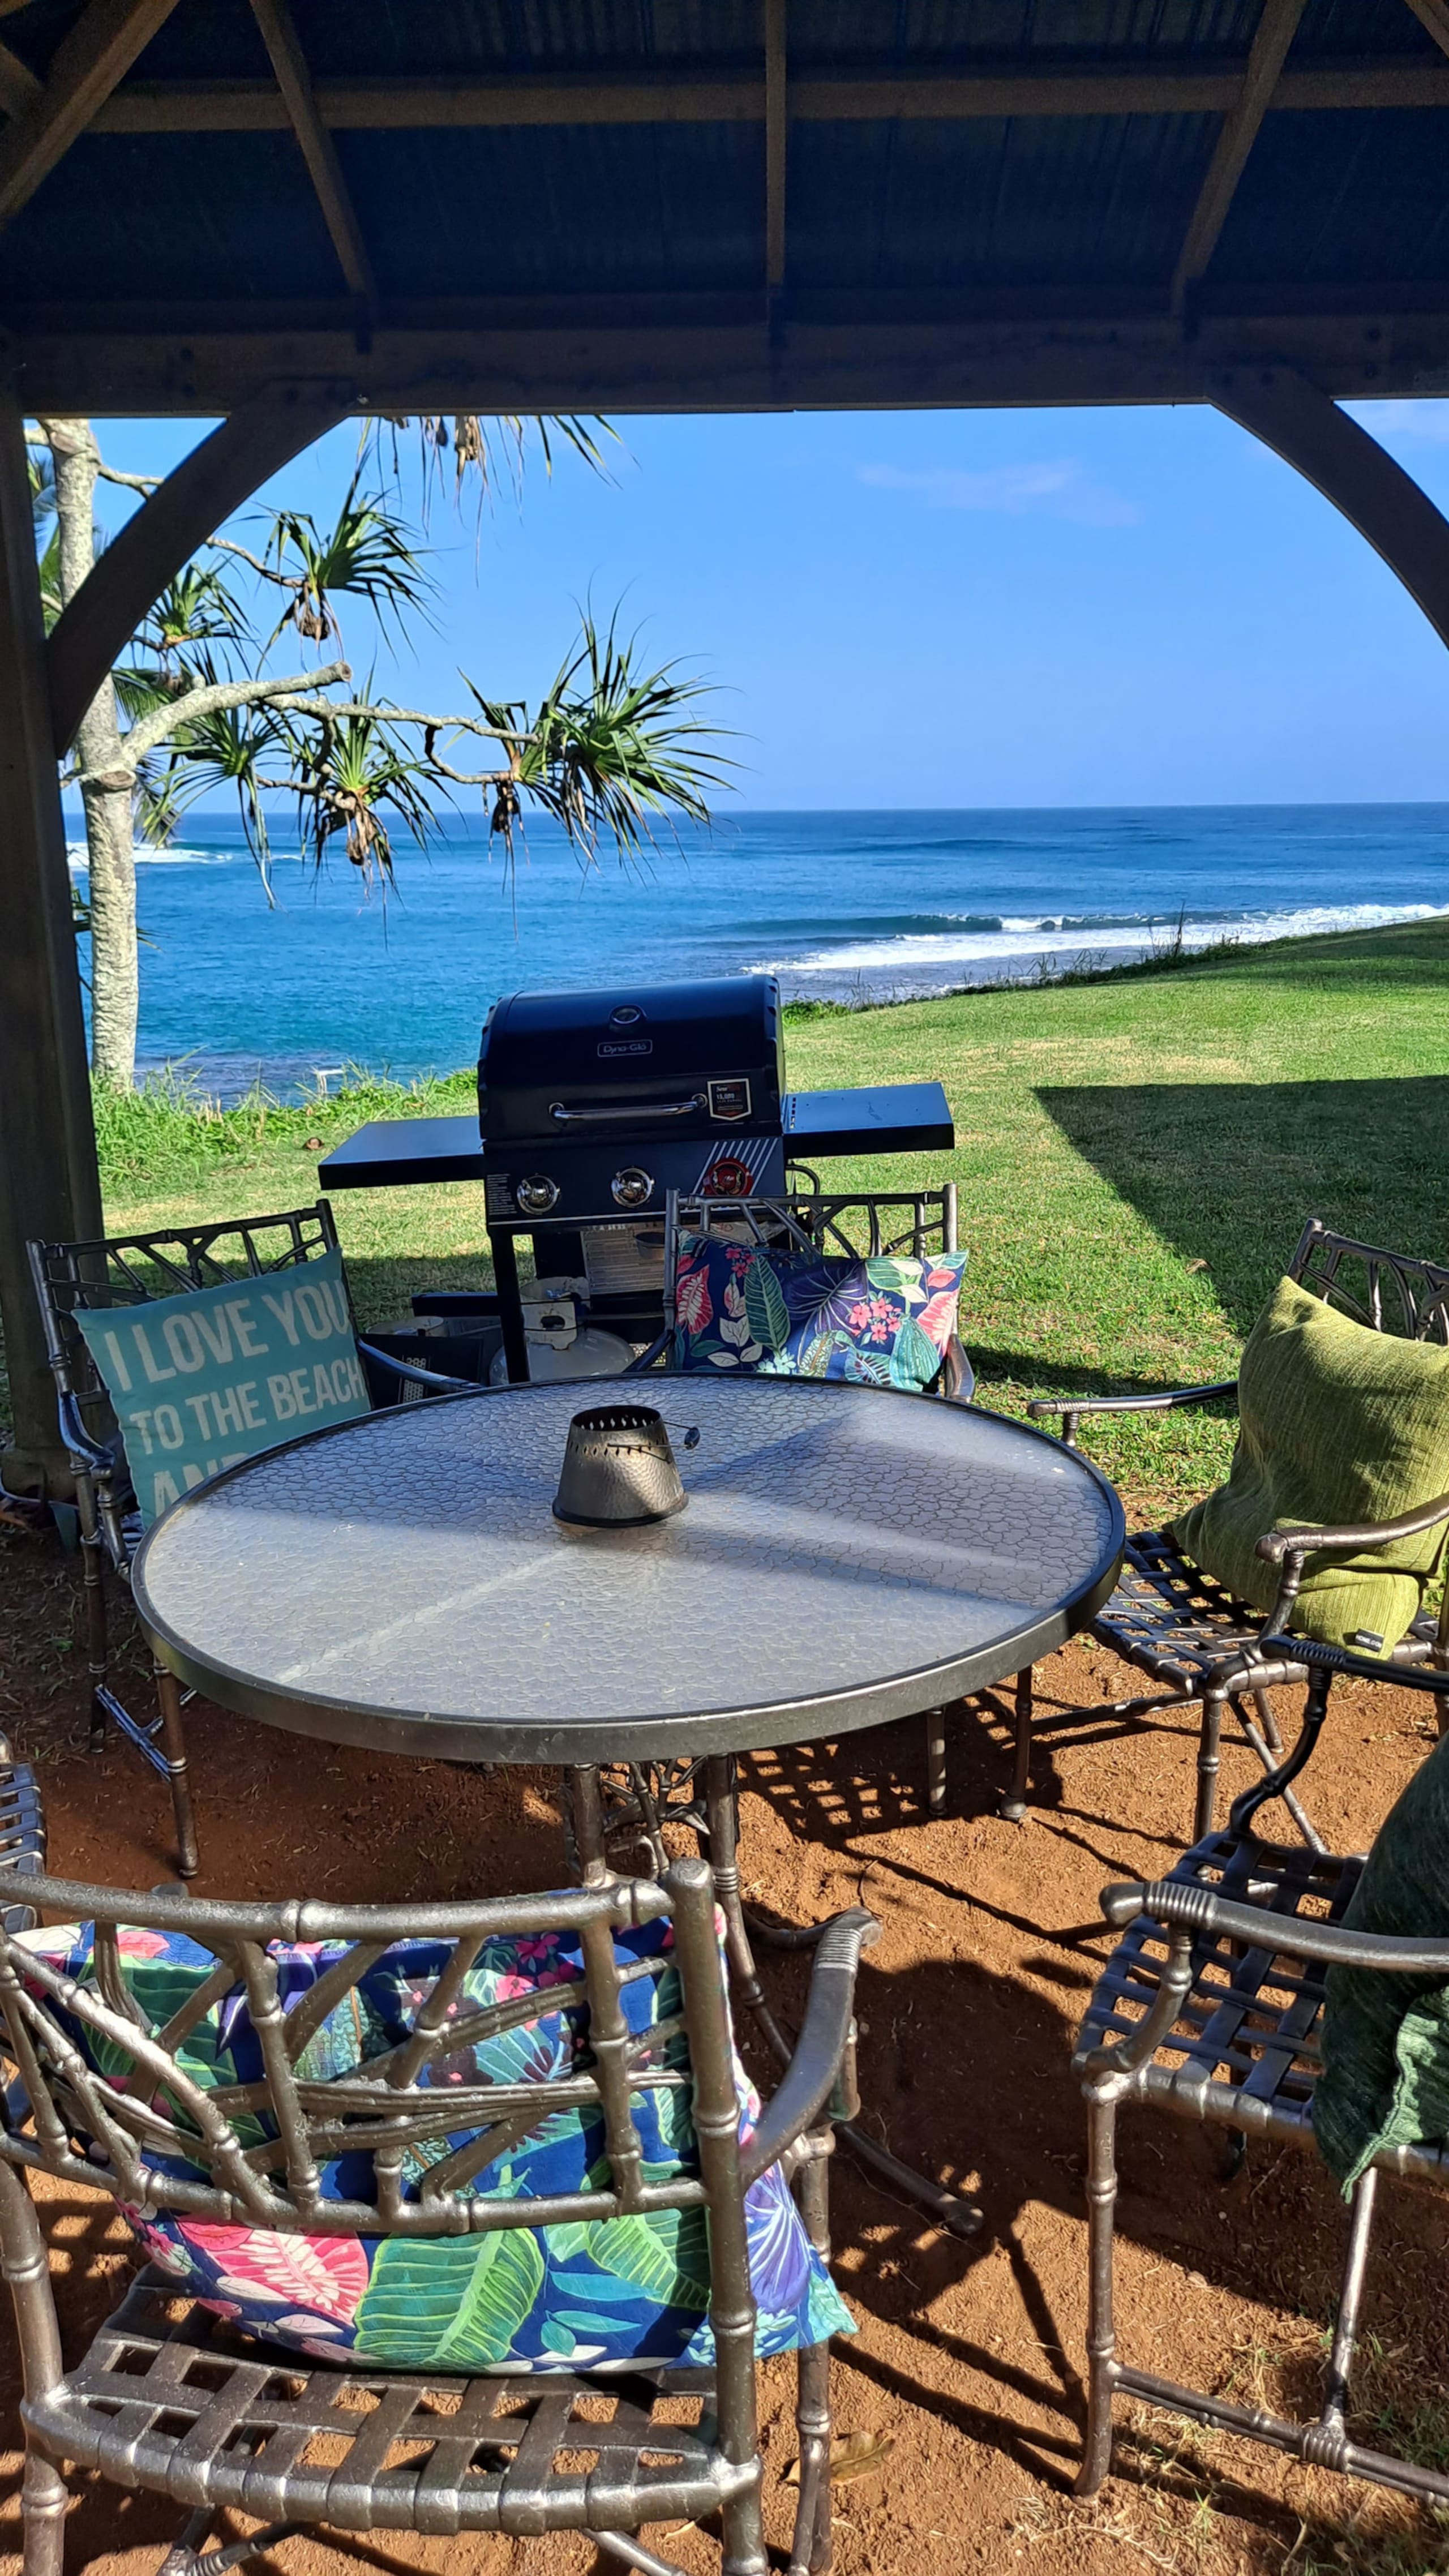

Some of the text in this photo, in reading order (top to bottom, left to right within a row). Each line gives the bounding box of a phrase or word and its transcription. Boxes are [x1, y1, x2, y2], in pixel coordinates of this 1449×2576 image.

[105, 1280, 349, 1392] I LOVE YOU
[130, 1358, 365, 1455] TO THE BEACH
